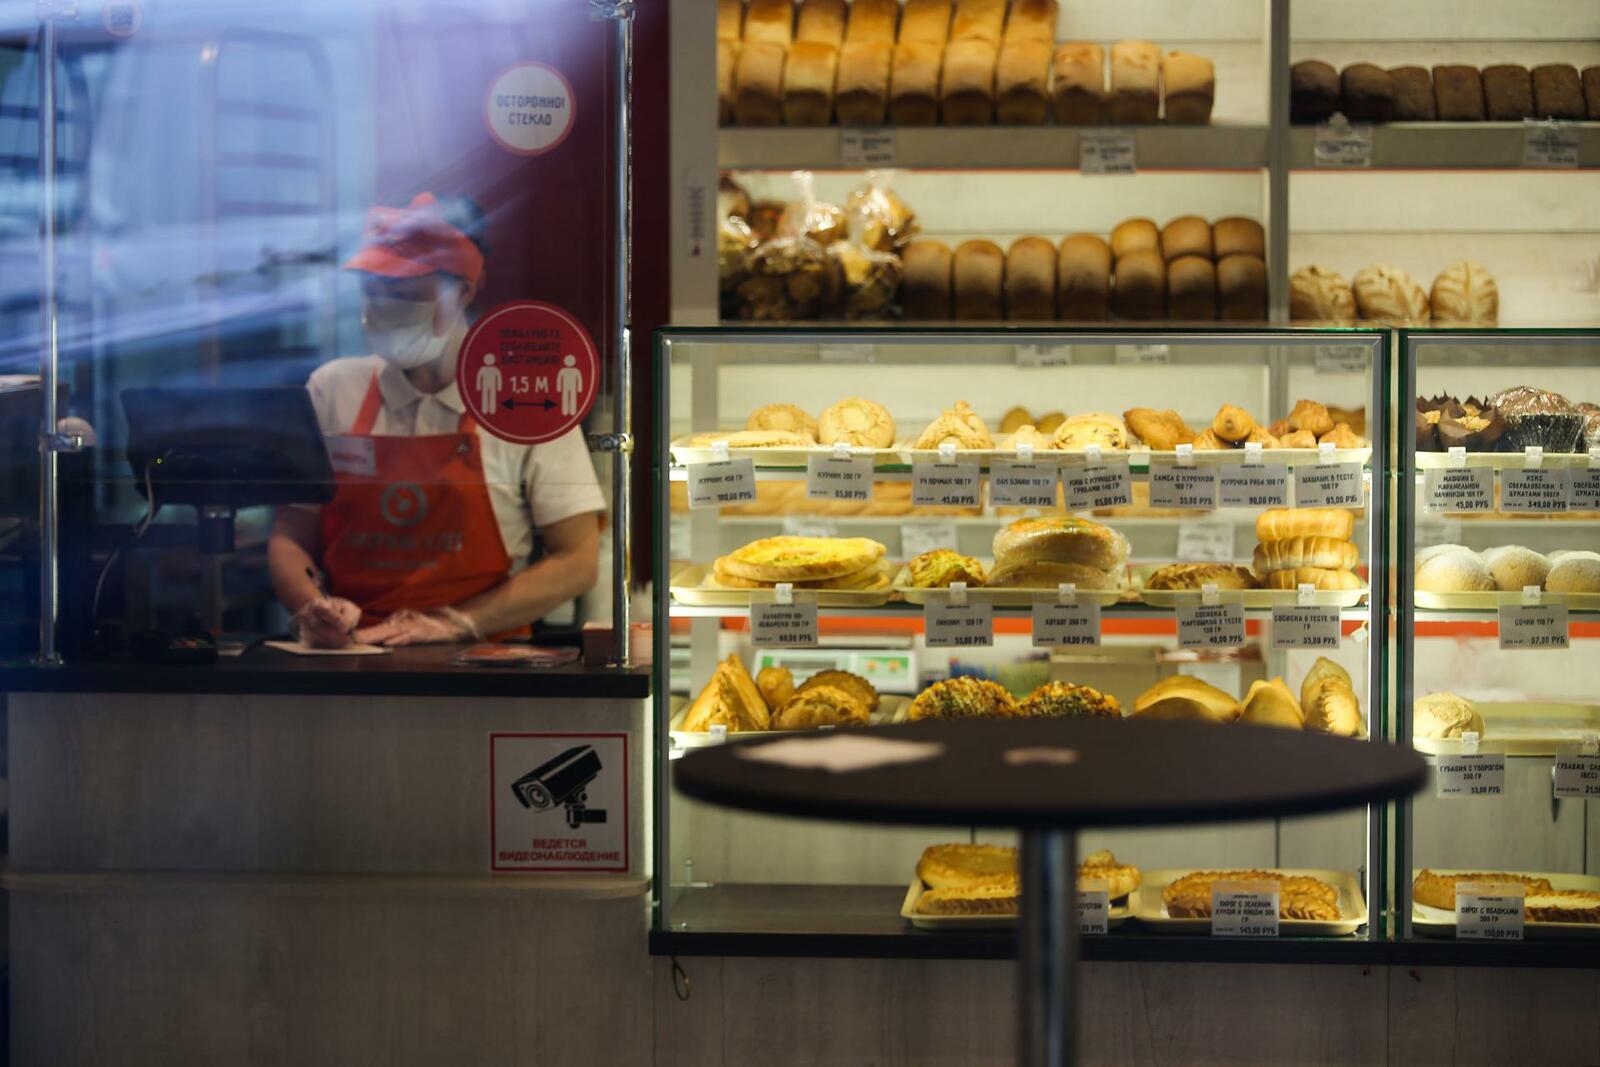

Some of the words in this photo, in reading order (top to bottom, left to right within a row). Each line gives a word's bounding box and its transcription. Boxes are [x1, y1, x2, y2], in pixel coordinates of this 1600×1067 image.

[508, 112, 552, 126] СТЕКЛО
[509, 376, 529, 394] 1,5
[535, 376, 549, 393] М
[1336, 473, 1354, 481] ТЕСТЕ
[1508, 482, 1555, 490] СВЕРДЛОВСКИЙ
[1345, 494, 1358, 503] РУБ
[1509, 490, 1541, 498] ЦУКАТАМИ
[961, 496, 975, 504] РУБ
[1038, 496, 1052, 505] РУБ
[1199, 497, 1213, 505] РУБ
[1268, 496, 1282, 504] РУБ
[1455, 500, 1474, 509] 45,00
[1474, 499, 1489, 509] РУБ
[1552, 499, 1567, 509] РУБ
[1547, 618, 1554, 626] ГР
[974, 636, 987, 645] РУБ
[1081, 636, 1095, 645] РУБ
[1229, 634, 1242, 643] РУБ
[1323, 636, 1337, 645] РУБ
[1551, 635, 1565, 644] РУБ
[533, 838, 586, 849] ВЕДЕТСЯ
[499, 851, 620, 862] ВИДЕОНАБЛЮДЕНИЕ
[1091, 924, 1105, 932] РУБ
[1262, 927, 1276, 935] РУБ
[1506, 929, 1520, 938] РУБ
